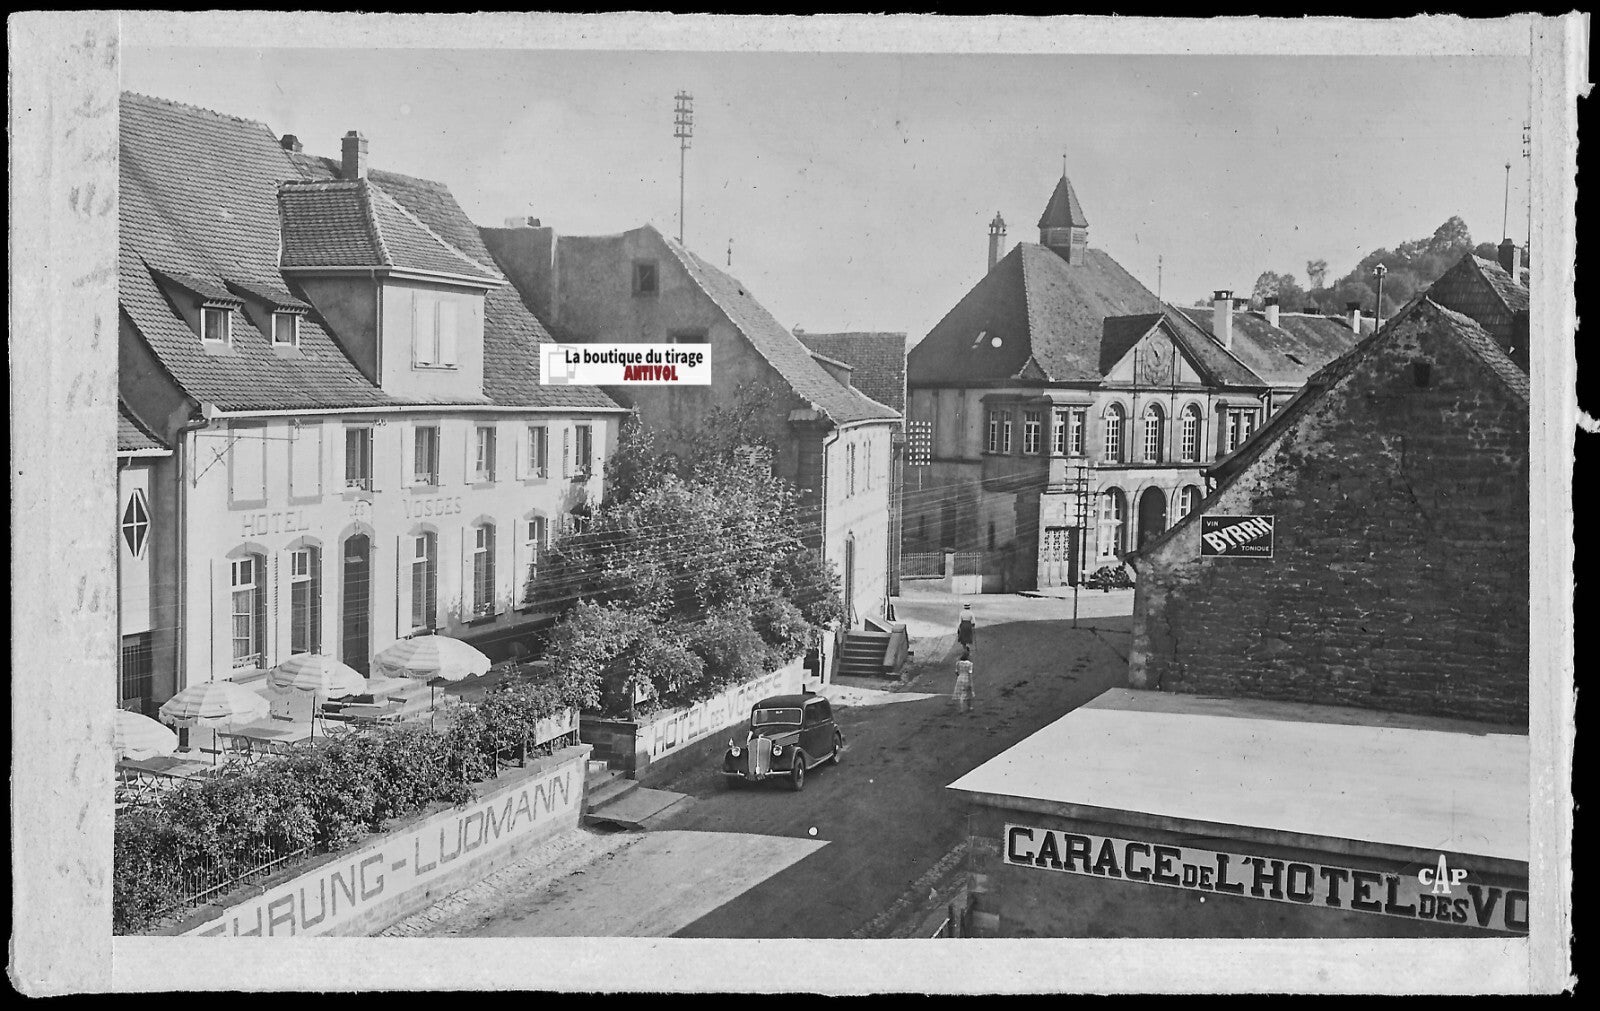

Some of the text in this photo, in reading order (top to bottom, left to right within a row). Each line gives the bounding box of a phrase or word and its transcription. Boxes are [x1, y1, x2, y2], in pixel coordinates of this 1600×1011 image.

[241, 510, 310, 537] HOTEL
[402, 496, 462, 519] VOSGES
[1202, 517, 1273, 555] BYRRH
[652, 703, 709, 757] HOTEL
[1182, 863, 1215, 891] DE
[1214, 853, 1417, 918] L'HOTEL
[1418, 893, 1470, 924] DES
